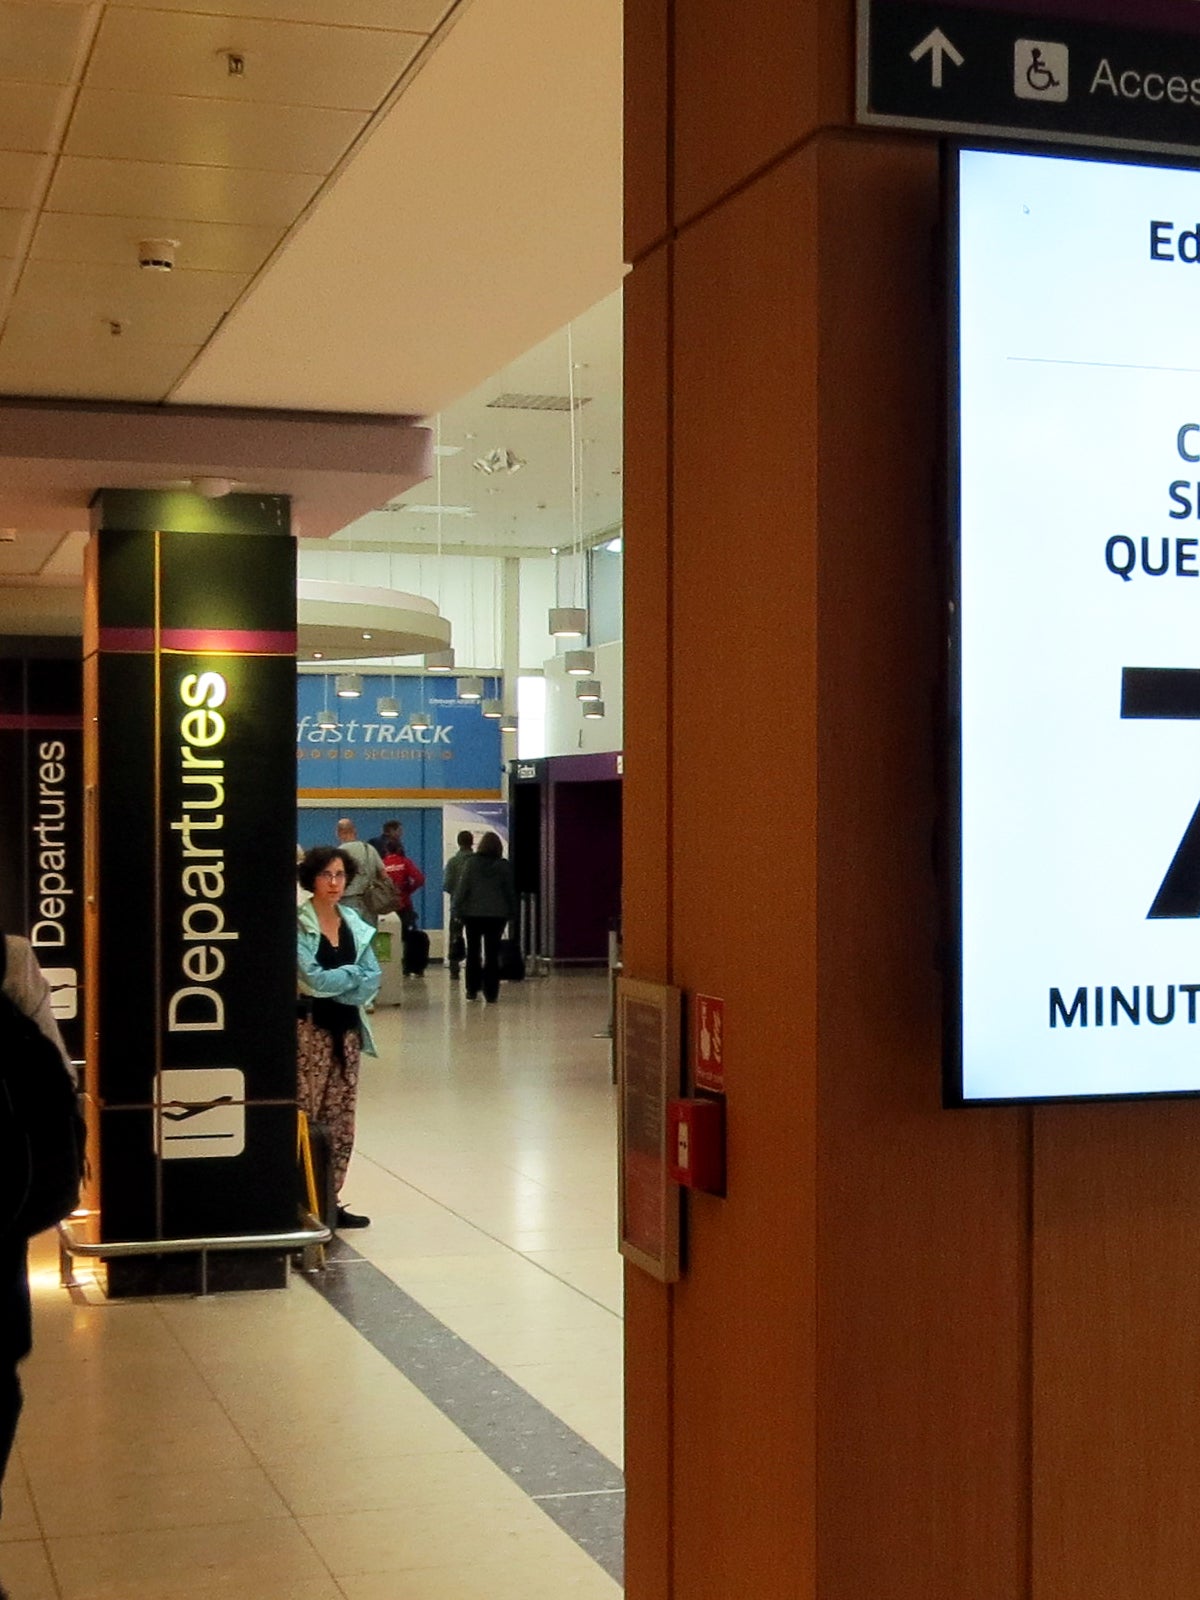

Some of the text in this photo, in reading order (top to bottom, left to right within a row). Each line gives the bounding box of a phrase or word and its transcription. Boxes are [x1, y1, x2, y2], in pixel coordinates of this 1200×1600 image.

[296, 716, 454, 743] fast TRACK
[32, 741, 73, 948] Departures
[169, 671, 239, 1032] Departures
